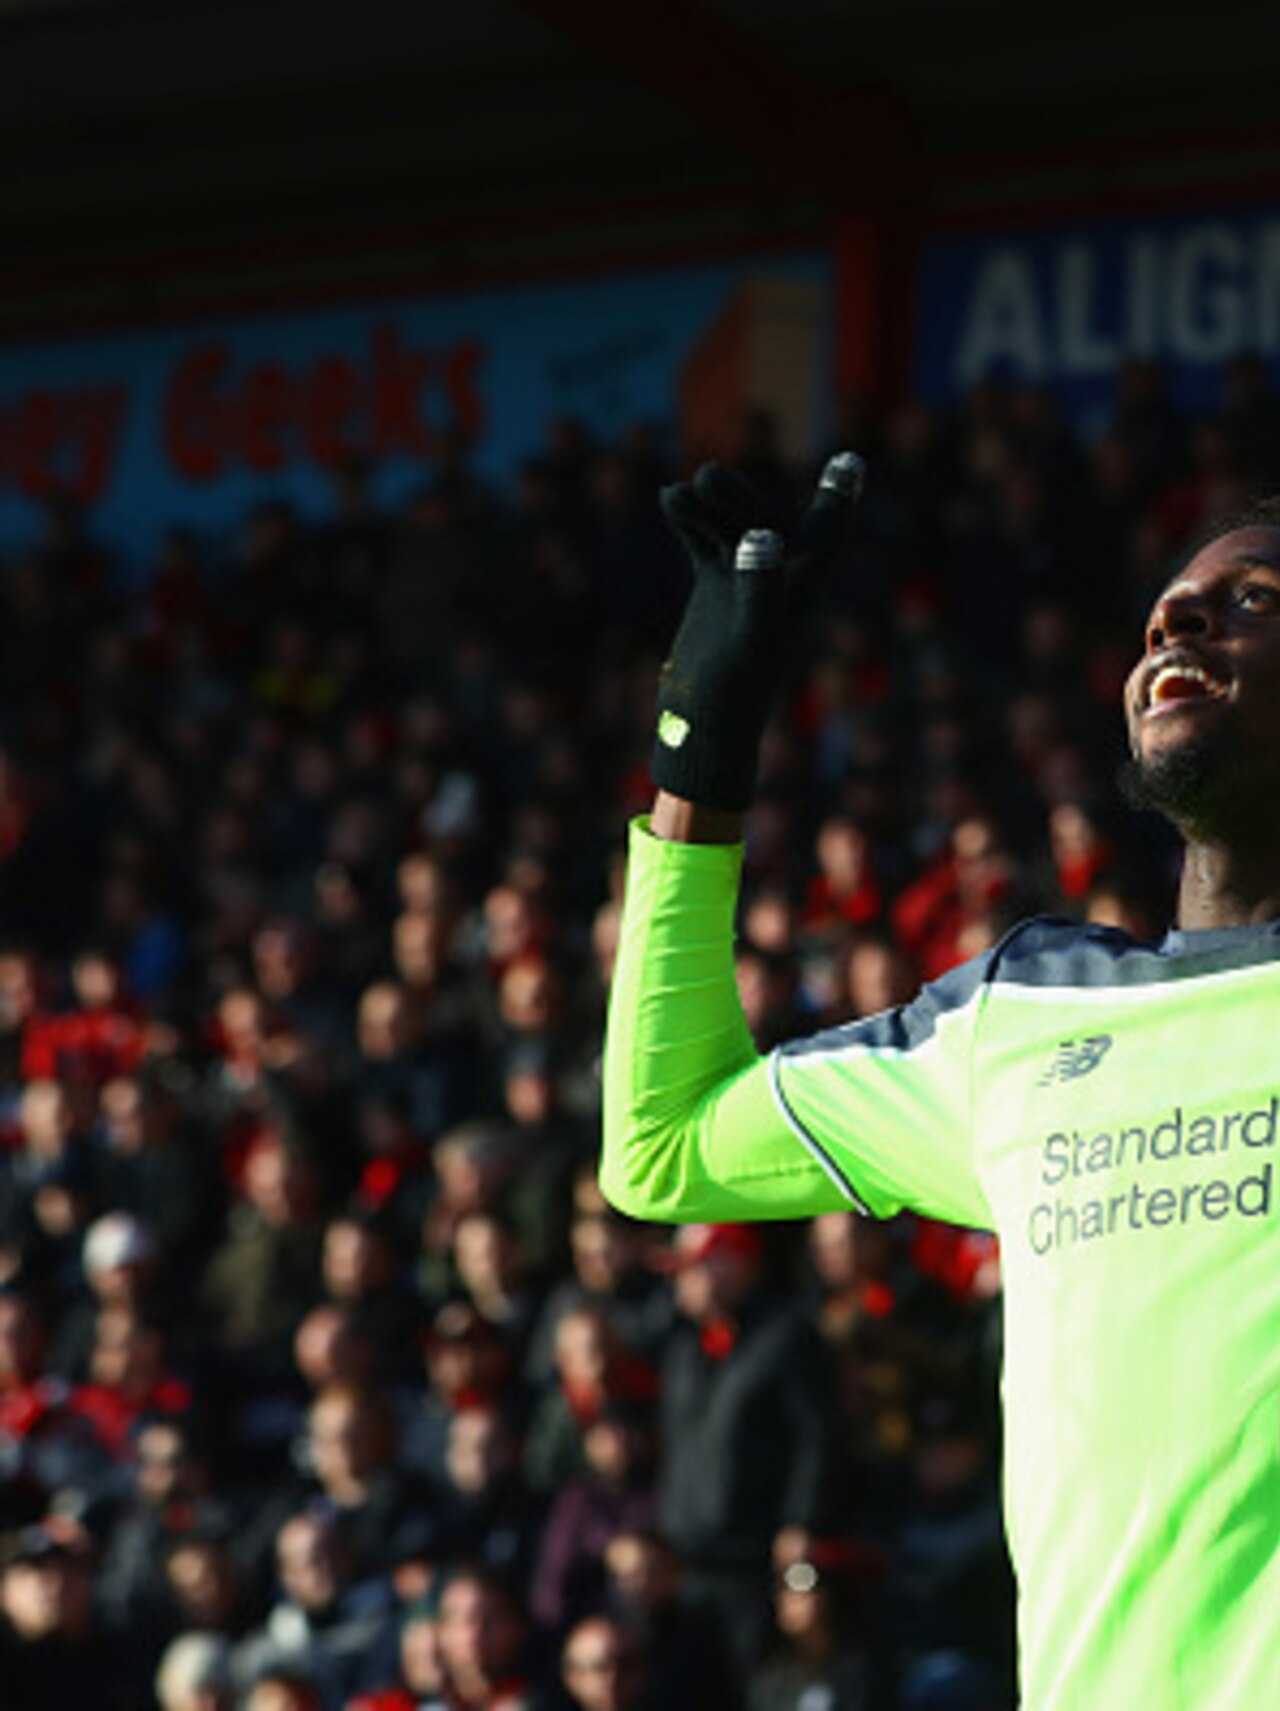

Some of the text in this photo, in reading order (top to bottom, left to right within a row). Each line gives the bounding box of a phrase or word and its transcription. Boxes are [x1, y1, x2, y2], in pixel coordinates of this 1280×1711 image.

[162, 320, 486, 482] Geeks
[1041, 1096, 1280, 1186] Standard
[1028, 1163, 1273, 1256] Chartered
